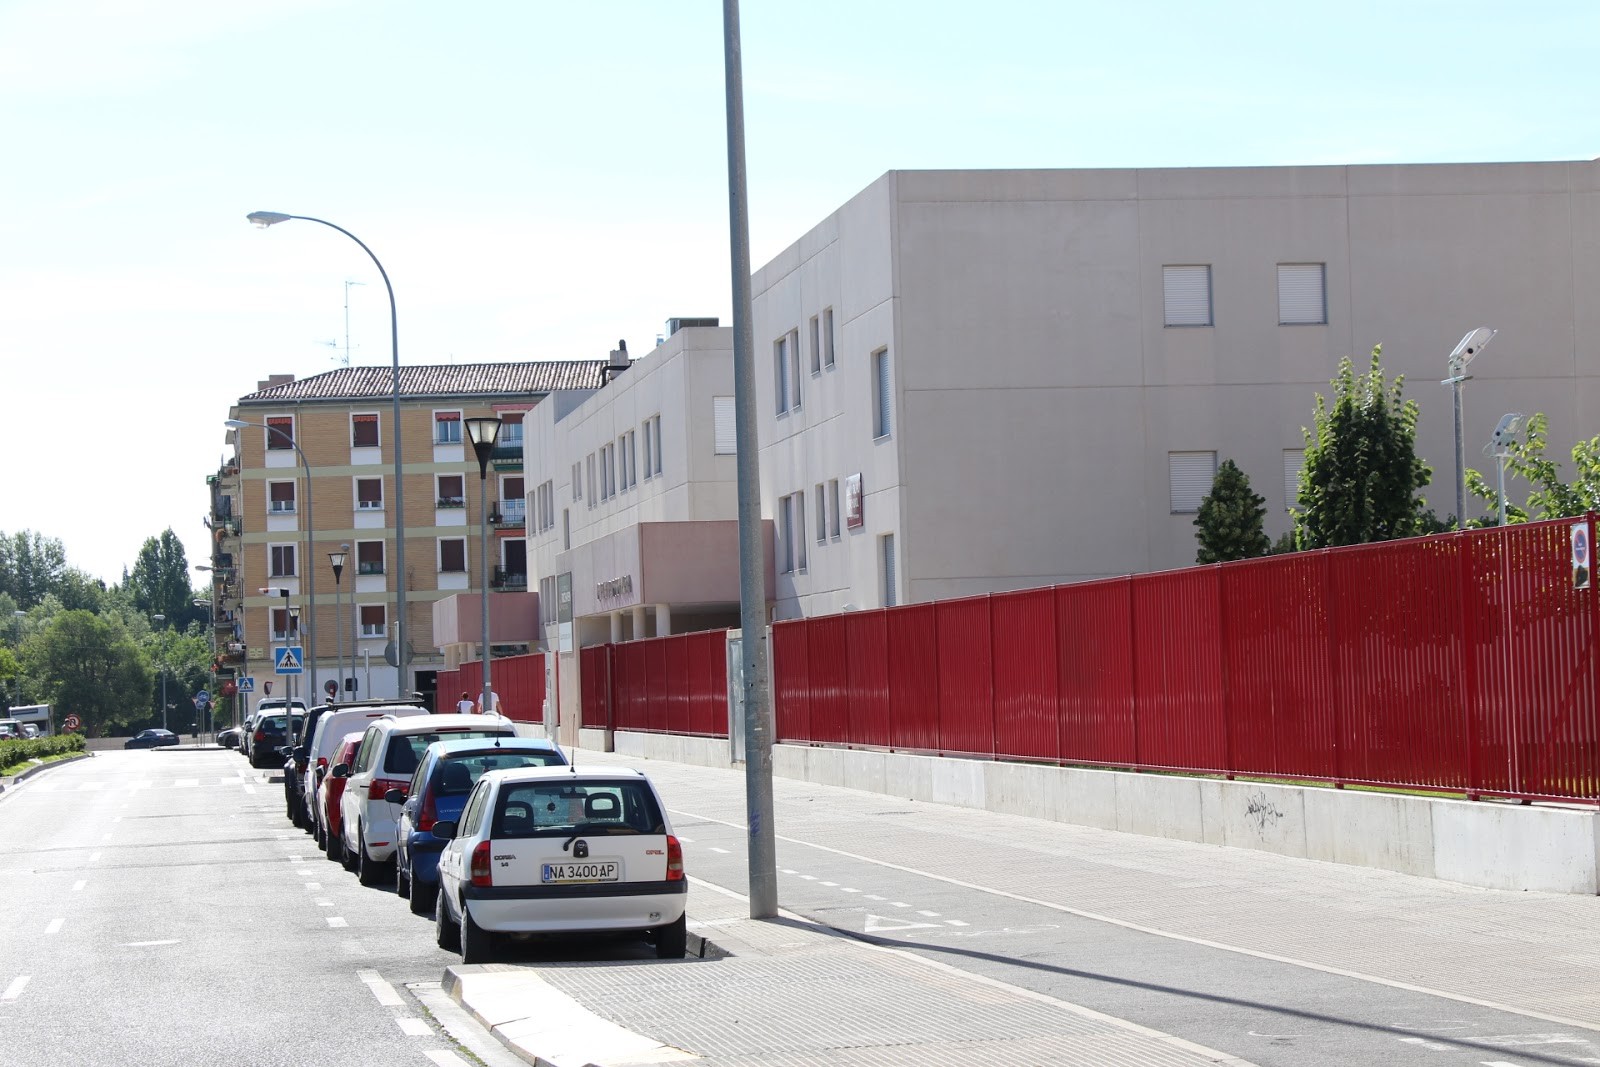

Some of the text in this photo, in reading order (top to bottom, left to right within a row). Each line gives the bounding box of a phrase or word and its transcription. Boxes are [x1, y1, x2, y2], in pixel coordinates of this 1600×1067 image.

[550, 866, 565, 879] NA
[568, 865, 598, 878] 3400
[599, 864, 615, 877] AP
